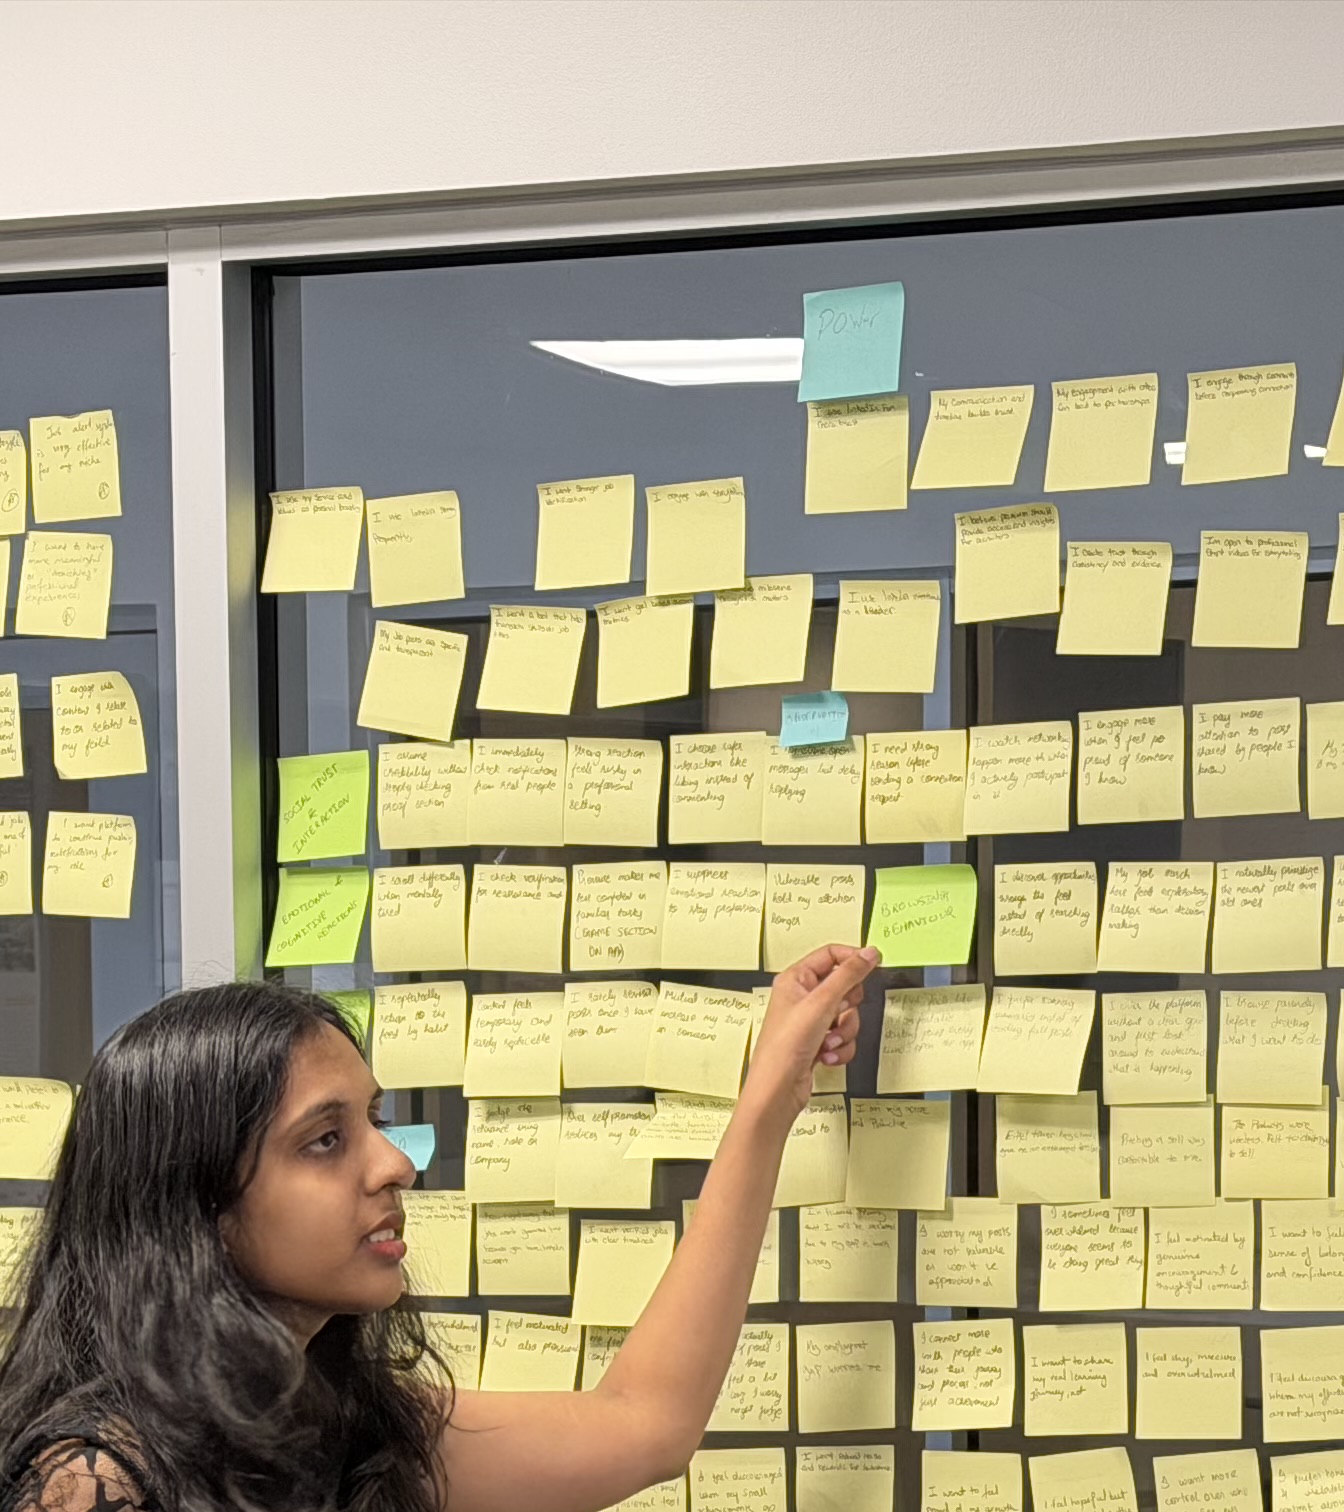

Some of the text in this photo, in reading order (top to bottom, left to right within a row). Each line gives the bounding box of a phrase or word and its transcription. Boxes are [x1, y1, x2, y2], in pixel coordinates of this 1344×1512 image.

[1213, 713, 1231, 728] pay
[1248, 726, 1260, 737] to
[283, 763, 338, 825] SOCIAL TRUST
[292, 794, 350, 855] INTERACTION
[282, 888, 331, 926] EMOTIONAL
[317, 900, 358, 942] REACTIONS
[277, 910, 327, 953] COGNITIVE
[1268, 1226, 1278, 1239] I
[1282, 1228, 1307, 1239] want
[1311, 1226, 1322, 1238] to
[1267, 1248, 1298, 1259] sense
[1301, 1246, 1312, 1267] of
[1266, 1266, 1344, 1281] and confidence
[1179, 1473, 1204, 1487] want
[1211, 1469, 1238, 1483] more
[1165, 1490, 1199, 1506] control
[1203, 1489, 1226, 1503] over
